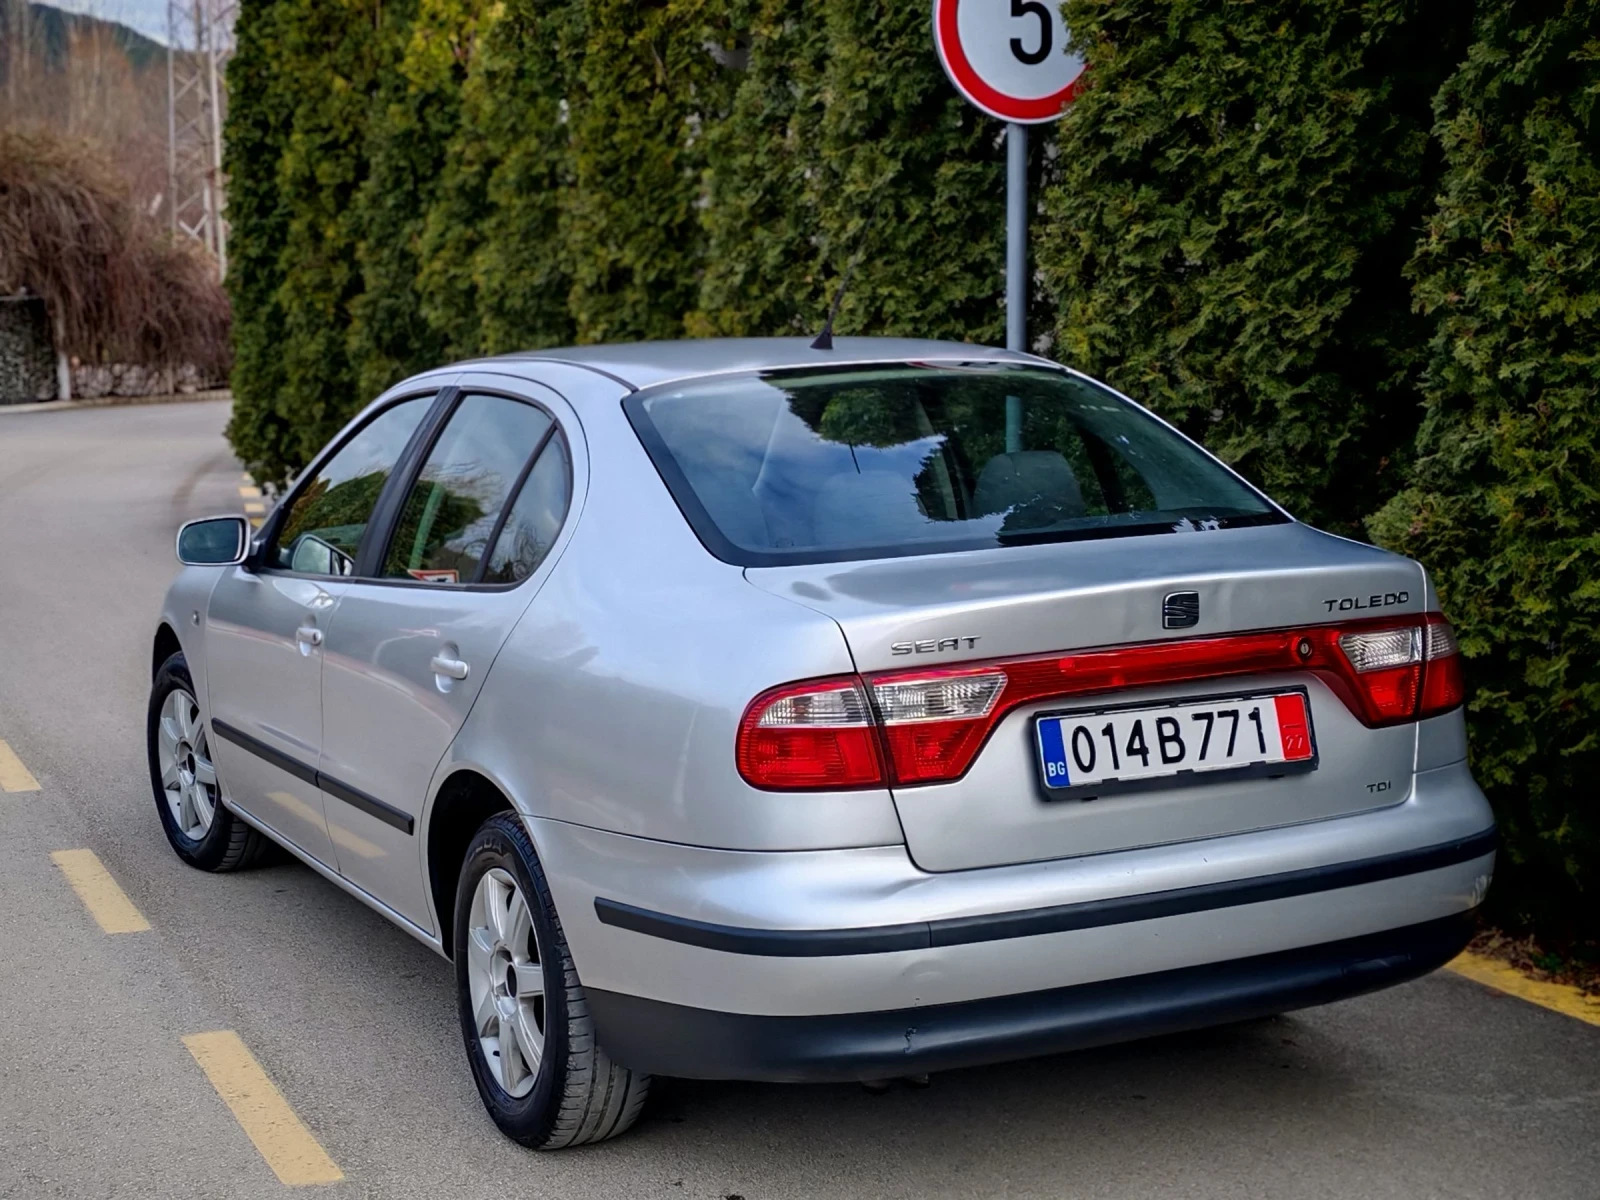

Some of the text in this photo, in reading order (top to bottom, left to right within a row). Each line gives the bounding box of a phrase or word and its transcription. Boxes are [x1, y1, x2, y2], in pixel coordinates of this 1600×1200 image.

[1010, 0, 1052, 65] 5
[1323, 591, 1409, 612] TOLEDO
[891, 635, 981, 656] SEAT
[1071, 706, 1267, 773] 014B771
[1047, 762, 1066, 777] BG
[1366, 780, 1391, 793] TDI
